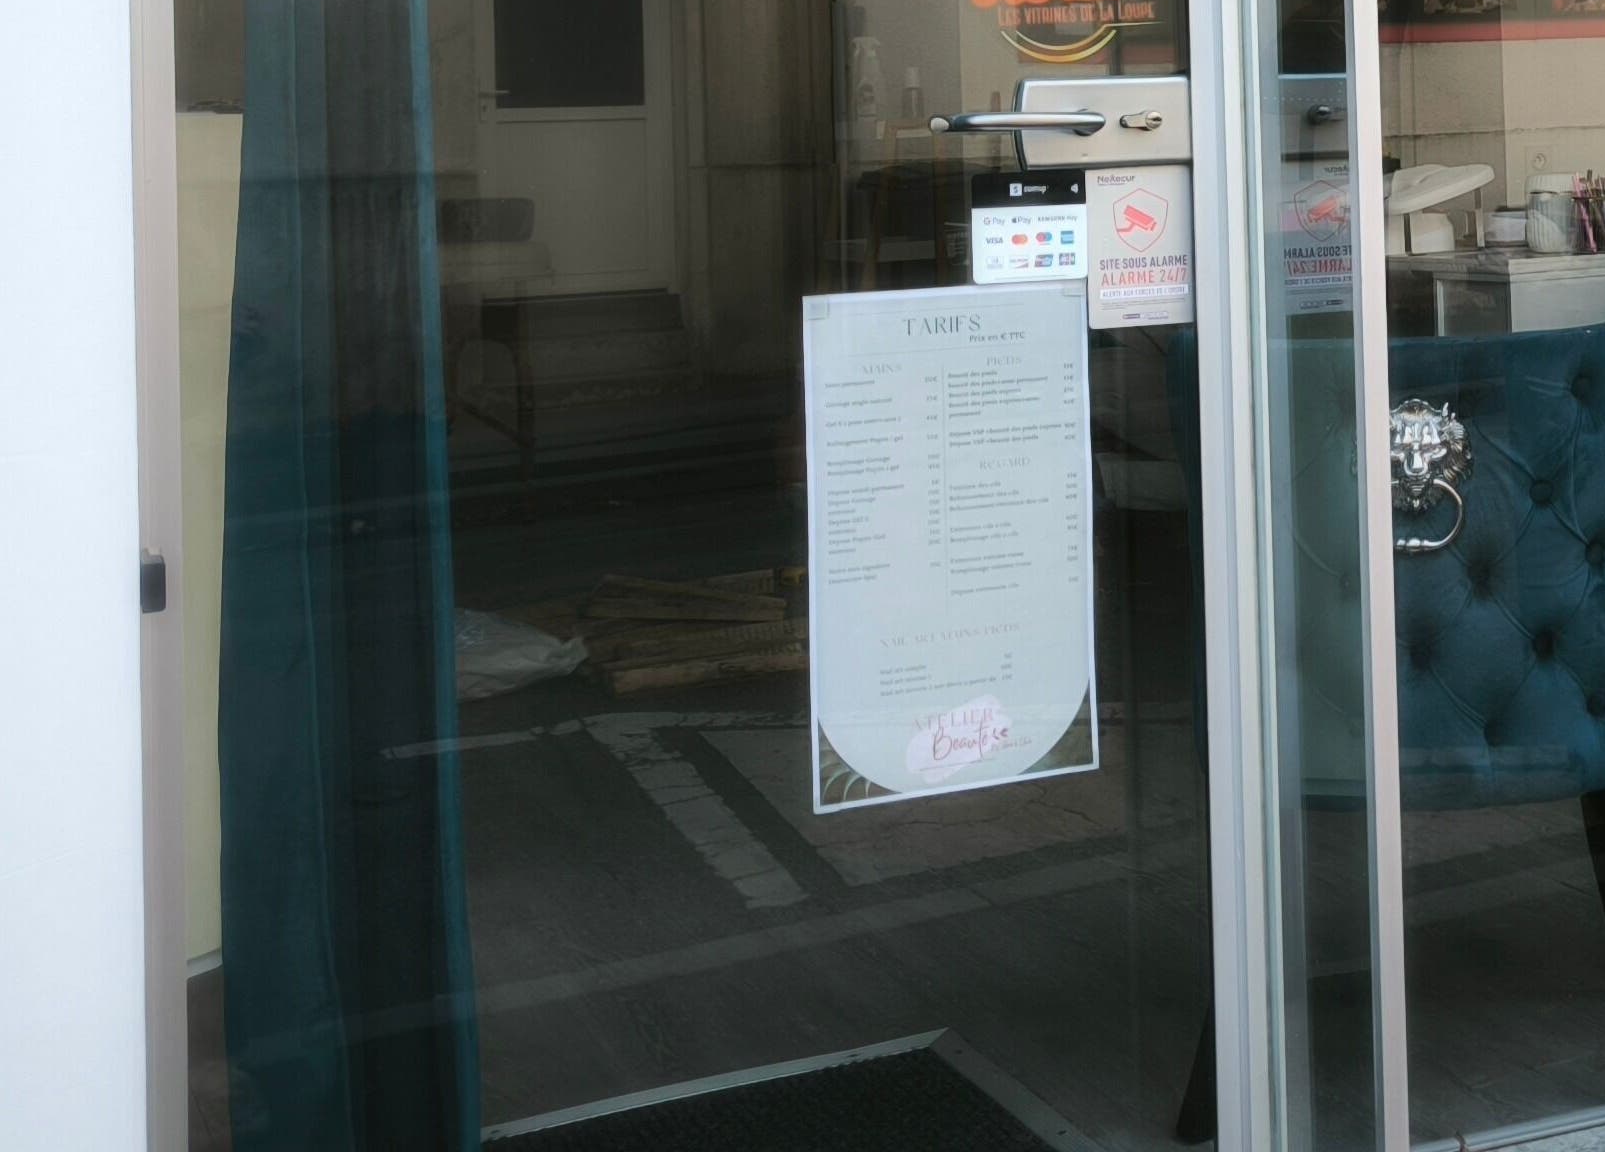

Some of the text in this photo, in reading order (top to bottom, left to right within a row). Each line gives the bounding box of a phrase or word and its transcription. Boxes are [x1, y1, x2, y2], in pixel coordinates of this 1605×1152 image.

[1100, 255, 1188, 271] SITE SOUS ALARME
[1101, 268, 1188, 286] ALARME 24/7
[903, 314, 982, 336] TARIFS
